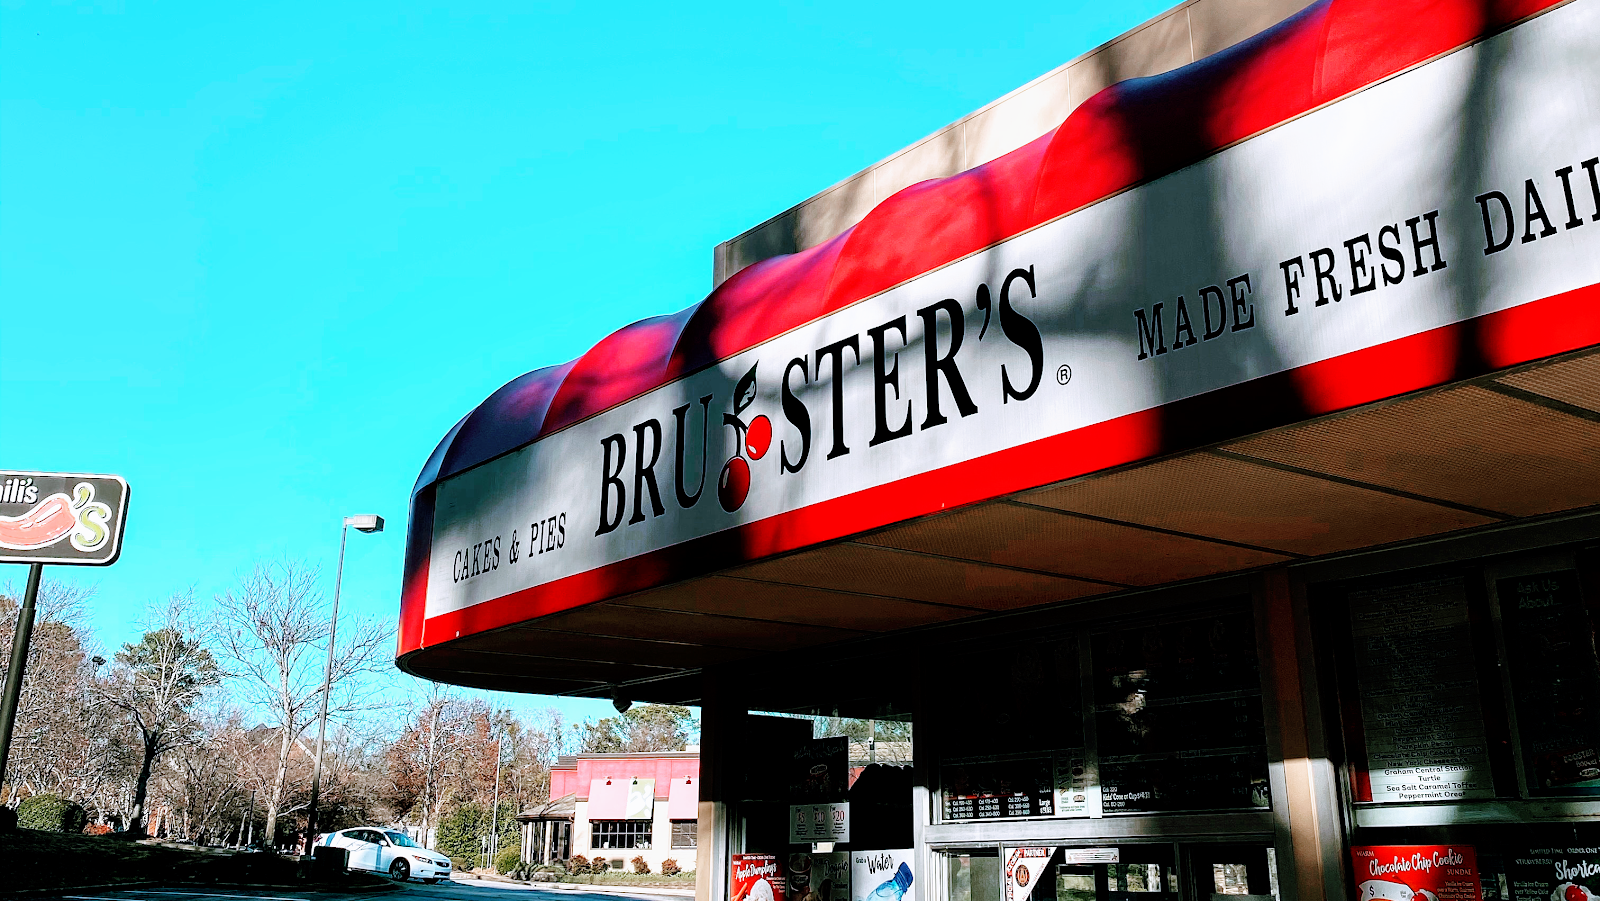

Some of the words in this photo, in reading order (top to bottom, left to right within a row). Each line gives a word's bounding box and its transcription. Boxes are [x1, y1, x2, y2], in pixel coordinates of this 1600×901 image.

[1133, 272, 1256, 361] MADE
[1279, 209, 1448, 317] FRESH
[453, 534, 502, 584] CAKES
[508, 528, 521, 565] &
[528, 511, 567, 558] PIES
[1384, 768, 1415, 776] Graham
[1415, 765, 1444, 774] Central
[1445, 764, 1474, 773] Station
[1401, 784, 1417, 792] Salt
[1418, 782, 1451, 791] Caramel
[1451, 781, 1478, 790] Toffee
[1398, 791, 1443, 800] Peppermint
[832, 810, 846, 822] $20
[1356, 849, 1375, 858] WARM
[866, 852, 895, 875] Water
[1368, 855, 1411, 876] Chocolate
[1410, 851, 1432, 874] Chip
[1432, 847, 1464, 868] Cookie
[1446, 868, 1472, 876] SUNDAE
